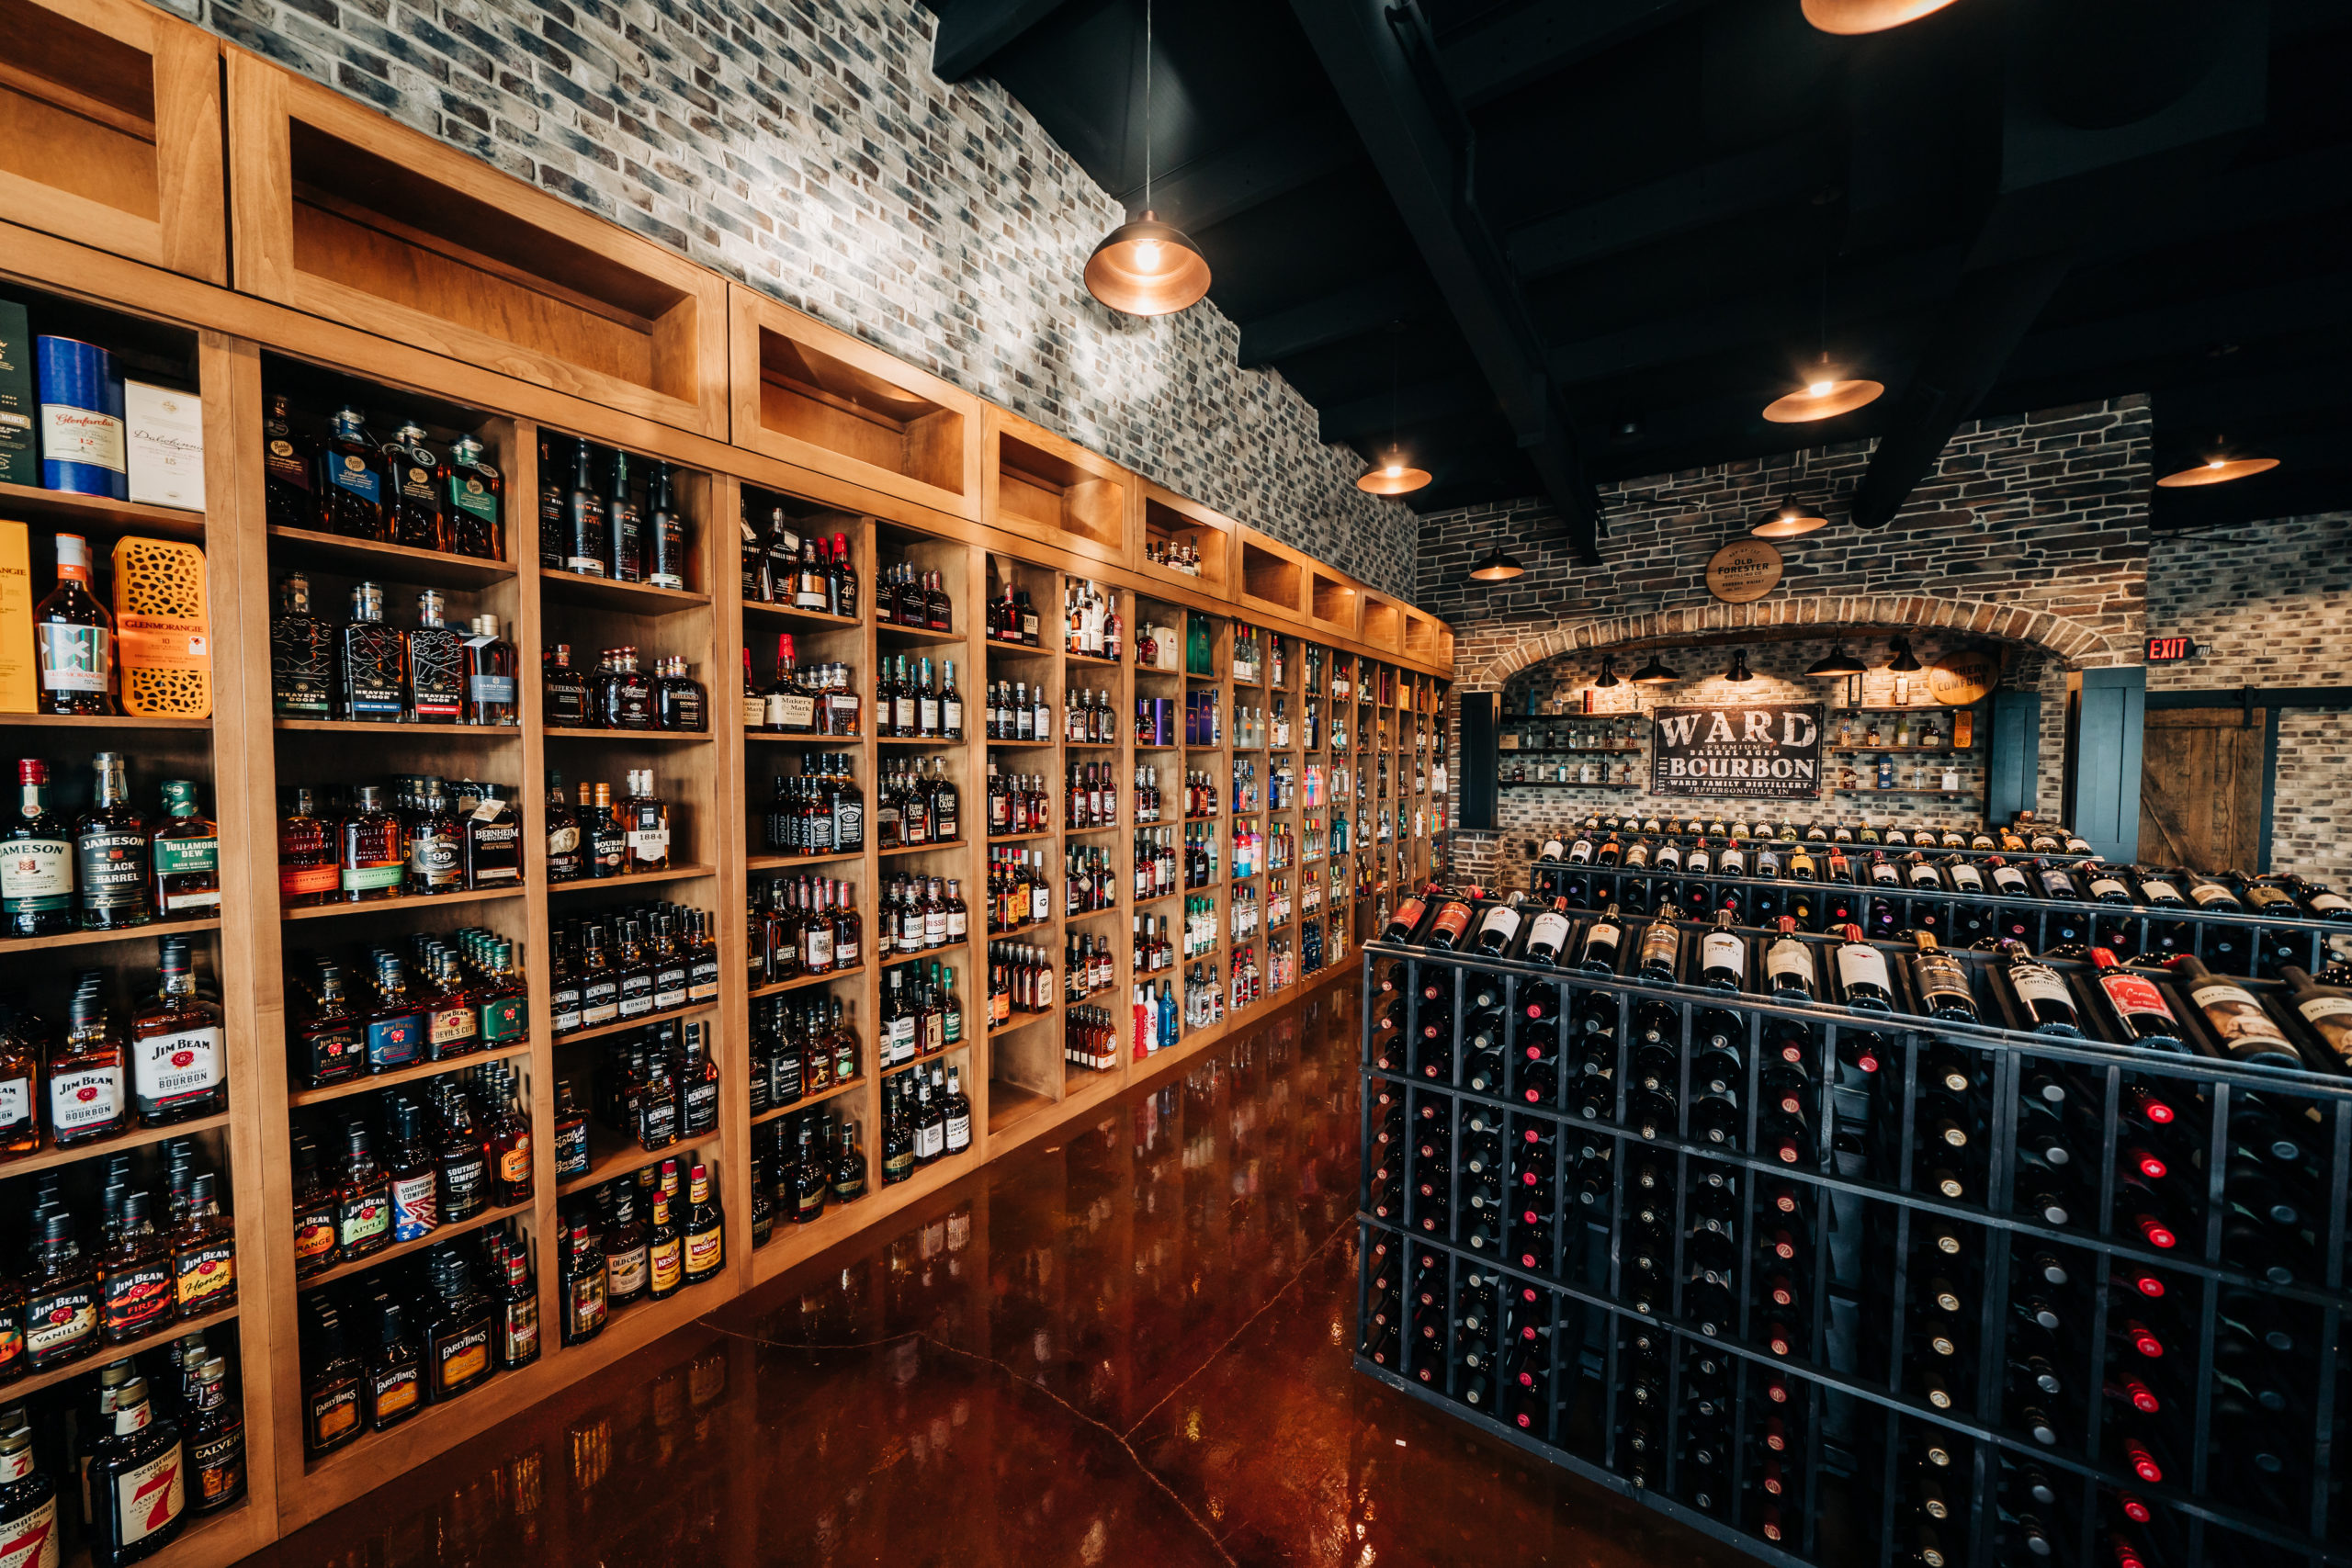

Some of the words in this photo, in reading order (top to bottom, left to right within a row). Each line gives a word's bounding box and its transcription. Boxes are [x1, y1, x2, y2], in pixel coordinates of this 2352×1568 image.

[55, 413, 114, 426] Glenfarclas
[1718, 563, 1769, 574] FORESTER
[842, 584, 854, 598] 46
[125, 620, 203, 632] GLENMORANGIE
[2150, 638, 2187, 659] EXIT
[1938, 675, 1987, 692] COMFORT
[1659, 711, 1817, 748] WARD
[1669, 758, 1815, 778] BOURBON
[938, 800, 955, 808] CRAIG
[939, 795, 955, 803] ELIJAH
[475, 829, 518, 840] BERNHEIM
[84, 837, 144, 850] JAMESON
[164, 841, 218, 851] TULLAMORE
[182, 850, 203, 858] DEW
[433, 852, 452, 861] 99
[99, 863, 135, 871] BLACK
[96, 874, 139, 883] BARREL
[777, 951, 795, 960] HONEY
[627, 999, 650, 1009] BONDED
[440, 1013, 452, 1022] JIM
[381, 1026, 394, 1036] JIM
[435, 1028, 458, 1039] DEVIL'S
[461, 1025, 473, 1033] CUT
[153, 1043, 175, 1061] JIM
[177, 1039, 209, 1050] BEAM
[318, 1040, 331, 1050] JIM
[60, 1080, 80, 1095] JIM
[83, 1077, 113, 1086] BEAM
[159, 1073, 207, 1089] BOURBON
[65, 1106, 110, 1121] BOURBON
[447, 1160, 482, 1177] SOUTHERN
[449, 1169, 481, 1183] COMFORT
[401, 1180, 433, 1194] SOUTHERN
[403, 1187, 431, 1200] COMFORT
[348, 1203, 363, 1216] JIM
[365, 1198, 386, 1206] BEAM
[307, 1215, 330, 1225] BEAM
[352, 1219, 384, 1235] APPLE
[693, 1240, 718, 1253] KESSLER
[183, 1256, 202, 1271] JIM
[203, 1250, 229, 1260] BEAM
[613, 1258, 625, 1268] OLD
[627, 1252, 644, 1264] CROW
[113, 1279, 132, 1295] JIM
[134, 1271, 164, 1282] BEAM
[186, 1271, 229, 1293] Honey
[32, 1303, 54, 1320] JIM
[56, 1294, 88, 1306] BEAM
[128, 1301, 154, 1314] FIRE
[36, 1322, 88, 1343] VANILLA
[134, 1410, 147, 1427] 7
[12, 1456, 28, 1477] 7
[133, 1449, 177, 1478] Seagram's
[131, 1461, 179, 1531] 7
